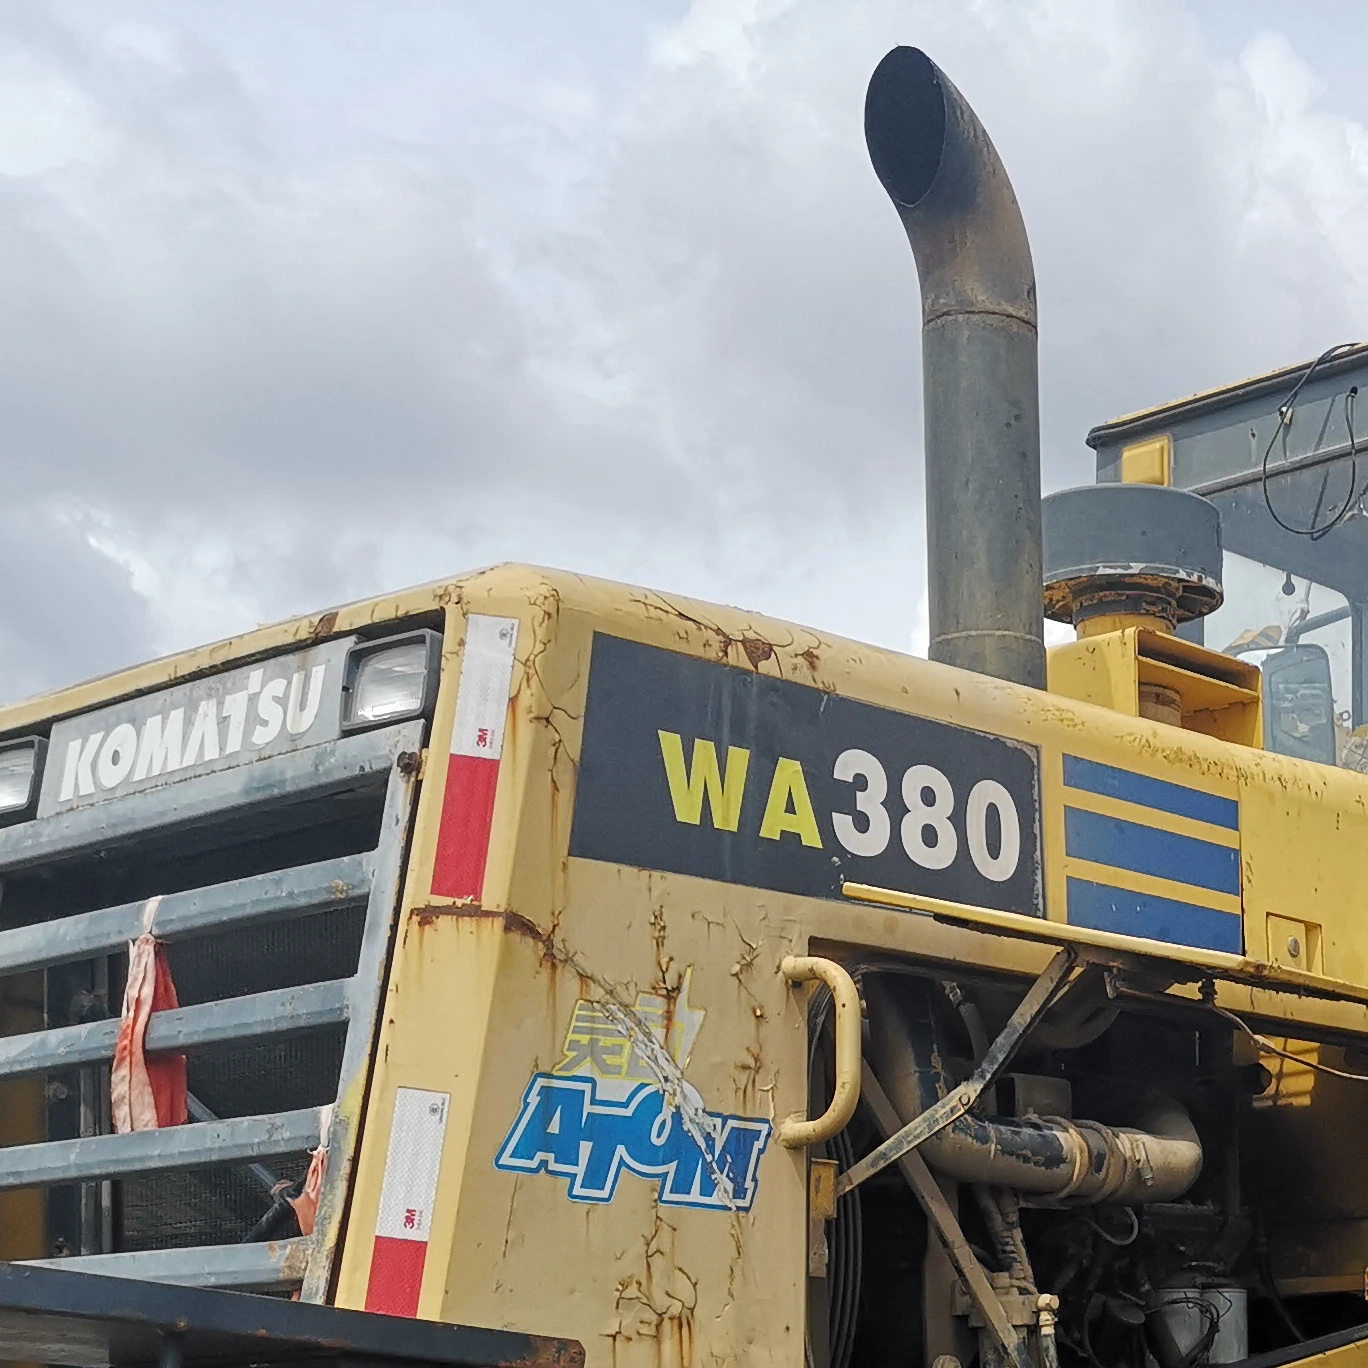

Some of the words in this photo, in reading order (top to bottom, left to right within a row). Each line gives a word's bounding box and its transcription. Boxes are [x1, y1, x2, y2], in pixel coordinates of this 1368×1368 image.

[60, 665, 326, 802] KOMATSU
[476, 727, 489, 748] 3M
[404, 1208, 417, 1230] 3M
